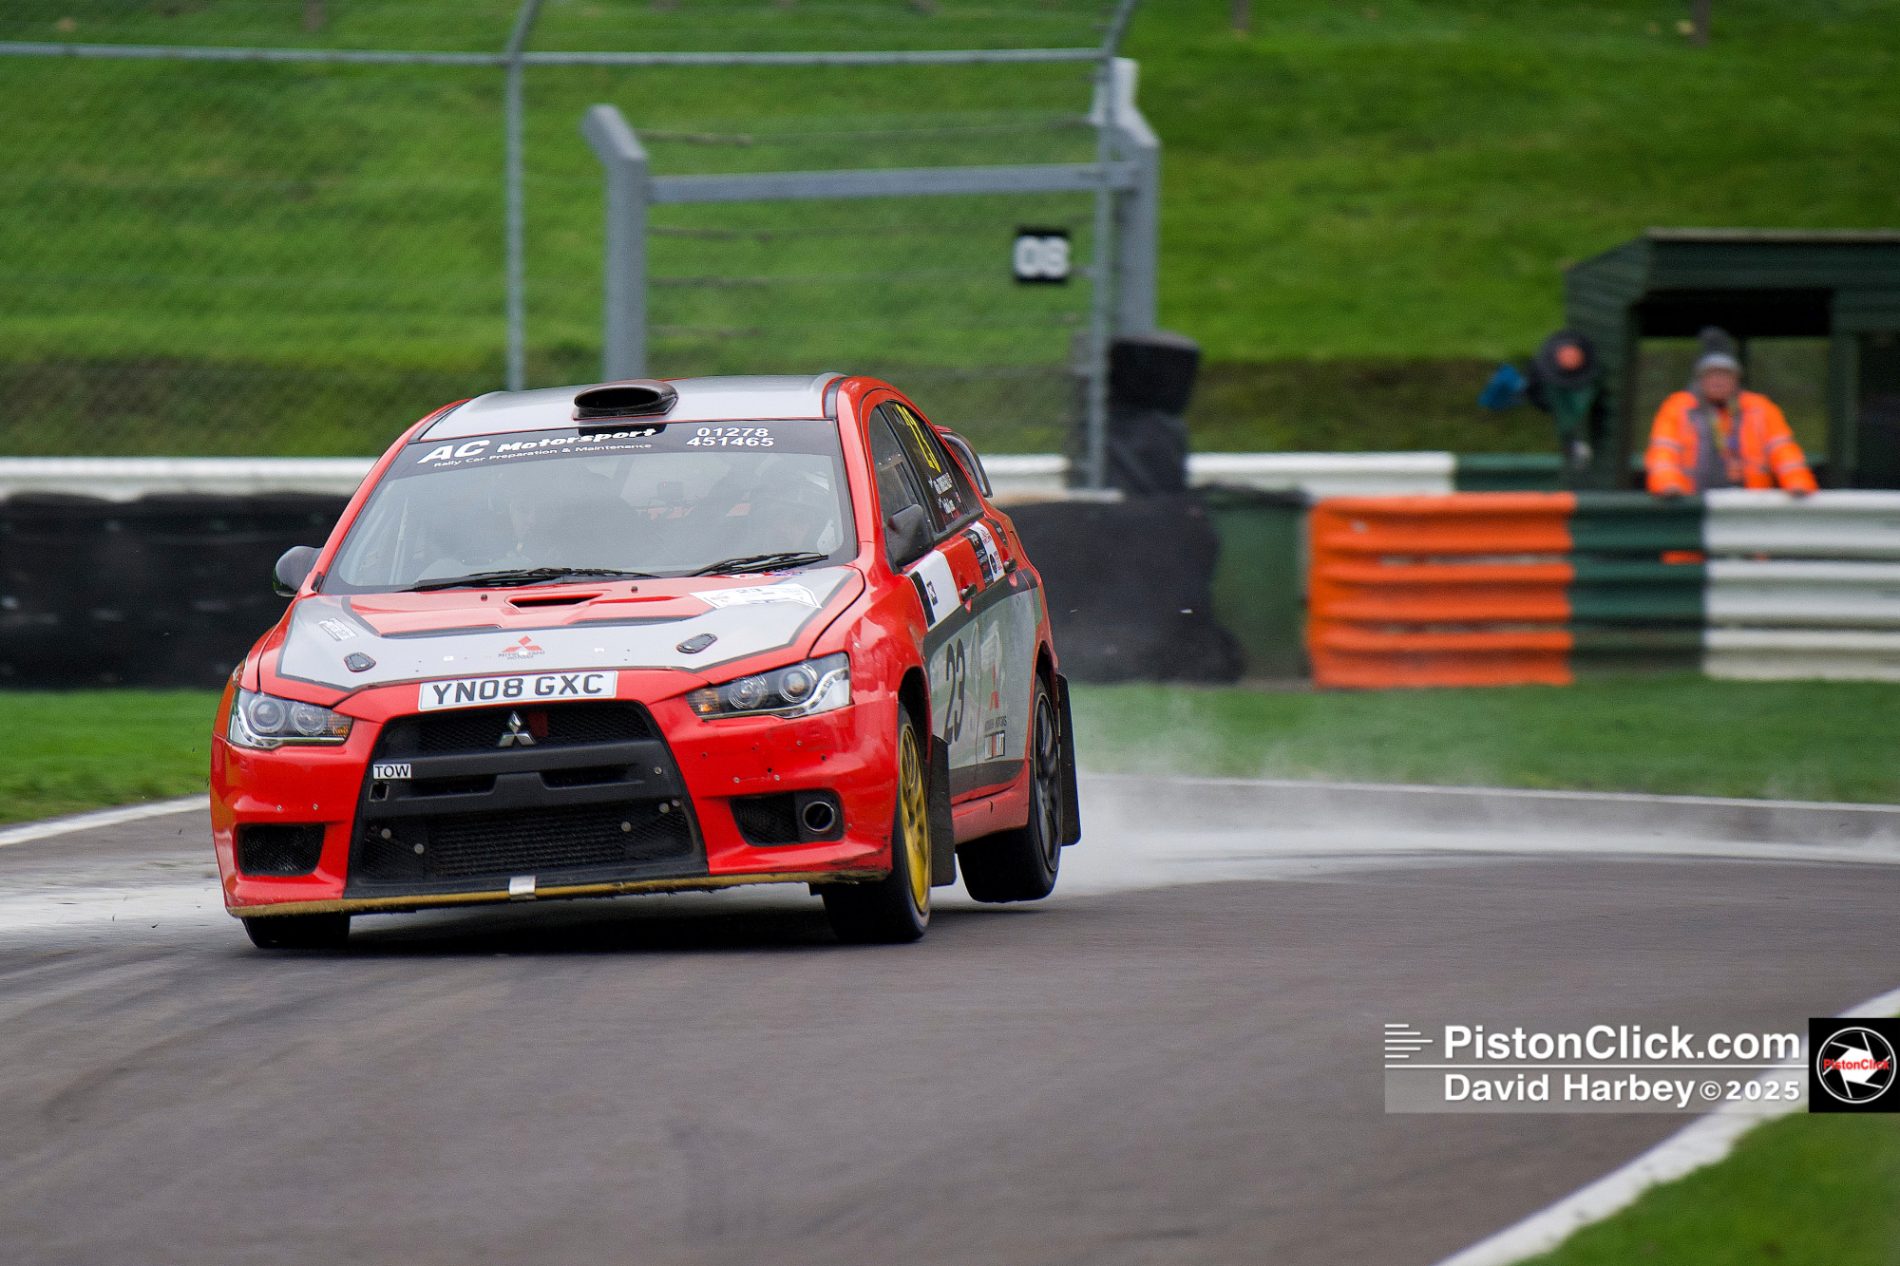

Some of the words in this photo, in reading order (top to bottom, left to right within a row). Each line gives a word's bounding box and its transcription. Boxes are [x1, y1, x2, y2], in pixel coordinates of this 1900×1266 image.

[686, 437, 775, 447] 451465
[697, 427, 769, 437] 01278
[417, 439, 490, 464] AC
[496, 427, 658, 453] Motorsport
[433, 460, 461, 468] Rally
[465, 456, 486, 464] Car
[489, 449, 558, 460] Preparation
[575, 443, 652, 452] Maintenance
[432, 677, 523, 705] YN08
[535, 673, 604, 697] GXC
[943, 638, 966, 745] 23
[375, 764, 410, 778] TOW
